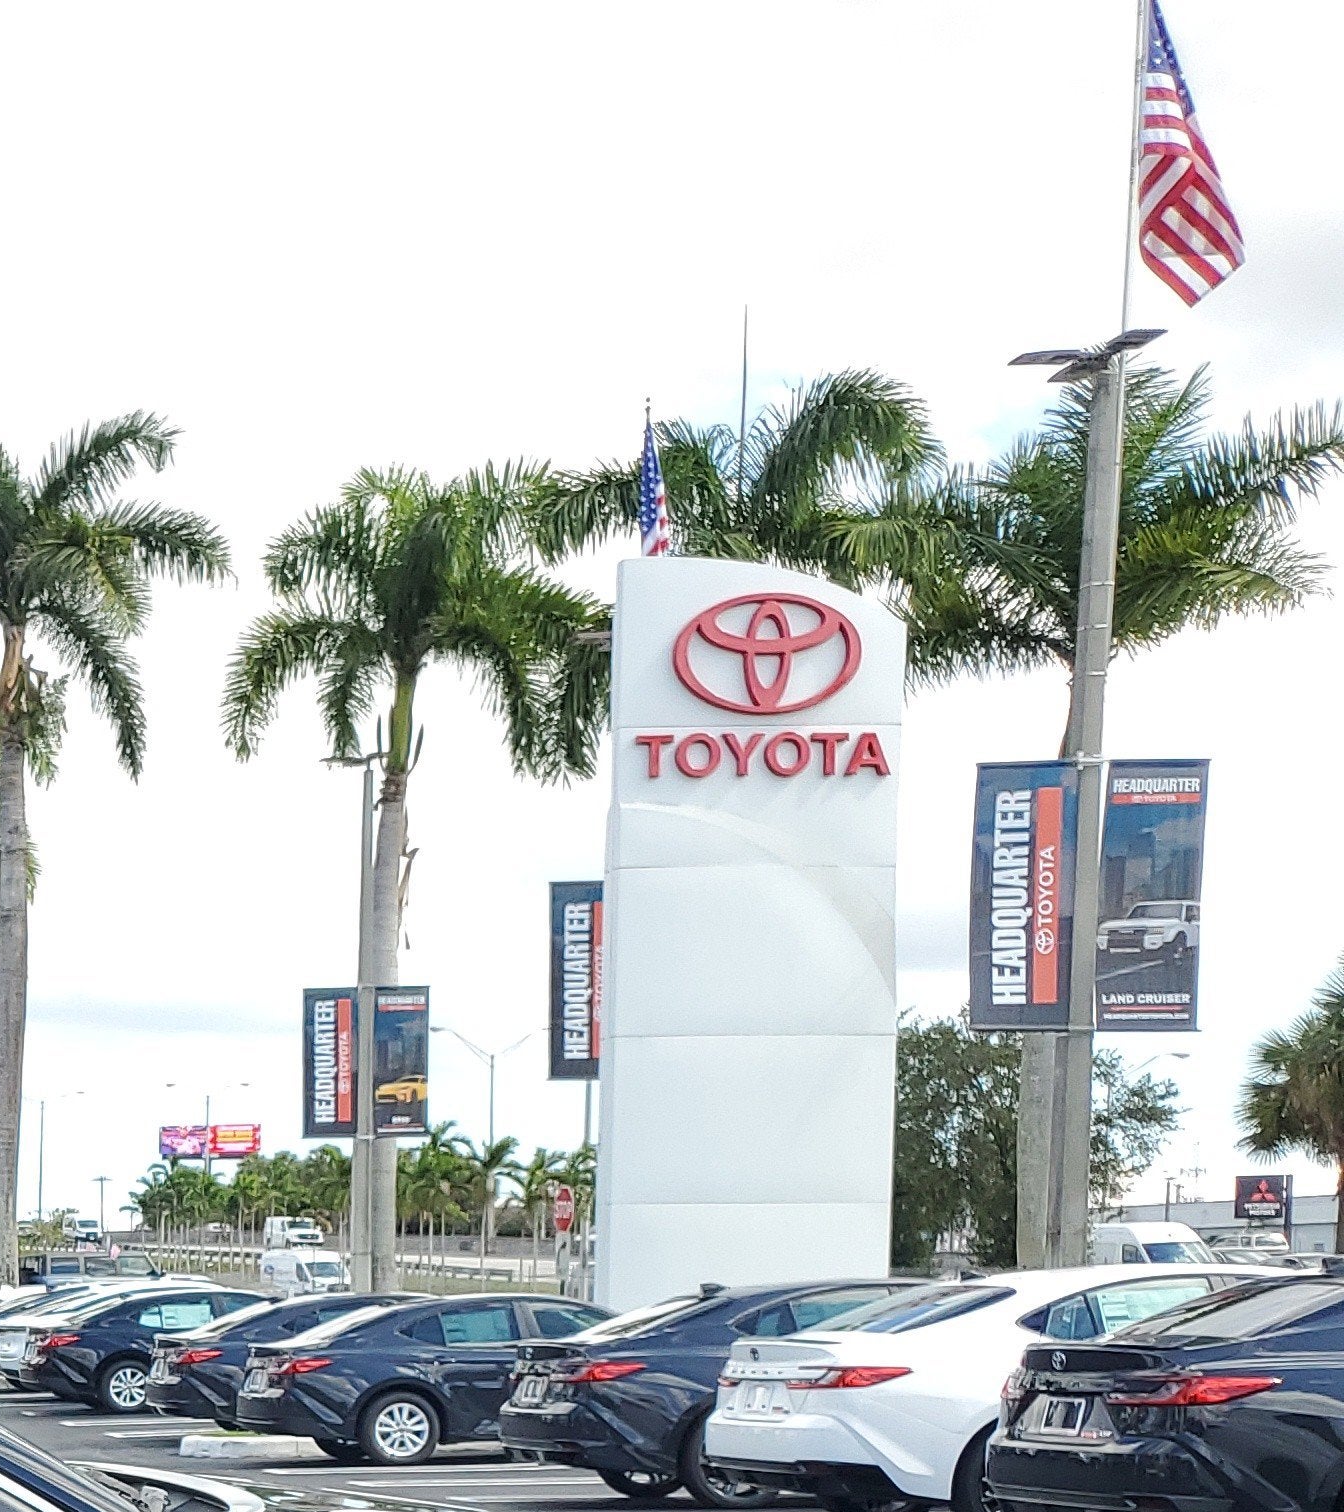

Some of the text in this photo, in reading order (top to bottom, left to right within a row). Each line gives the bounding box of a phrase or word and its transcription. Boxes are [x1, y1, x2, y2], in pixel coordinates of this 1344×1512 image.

[635, 731, 891, 778] TOYOTA
[1112, 777, 1201, 794] HEADQUARTER
[991, 788, 1033, 1006] HEADQUARTER
[1037, 845, 1056, 927] TOYOTA
[563, 902, 592, 1060] HEADQUARTER
[1101, 992, 1191, 1005] LAND CRUISER
[314, 999, 337, 1124] HEADQUARTER
